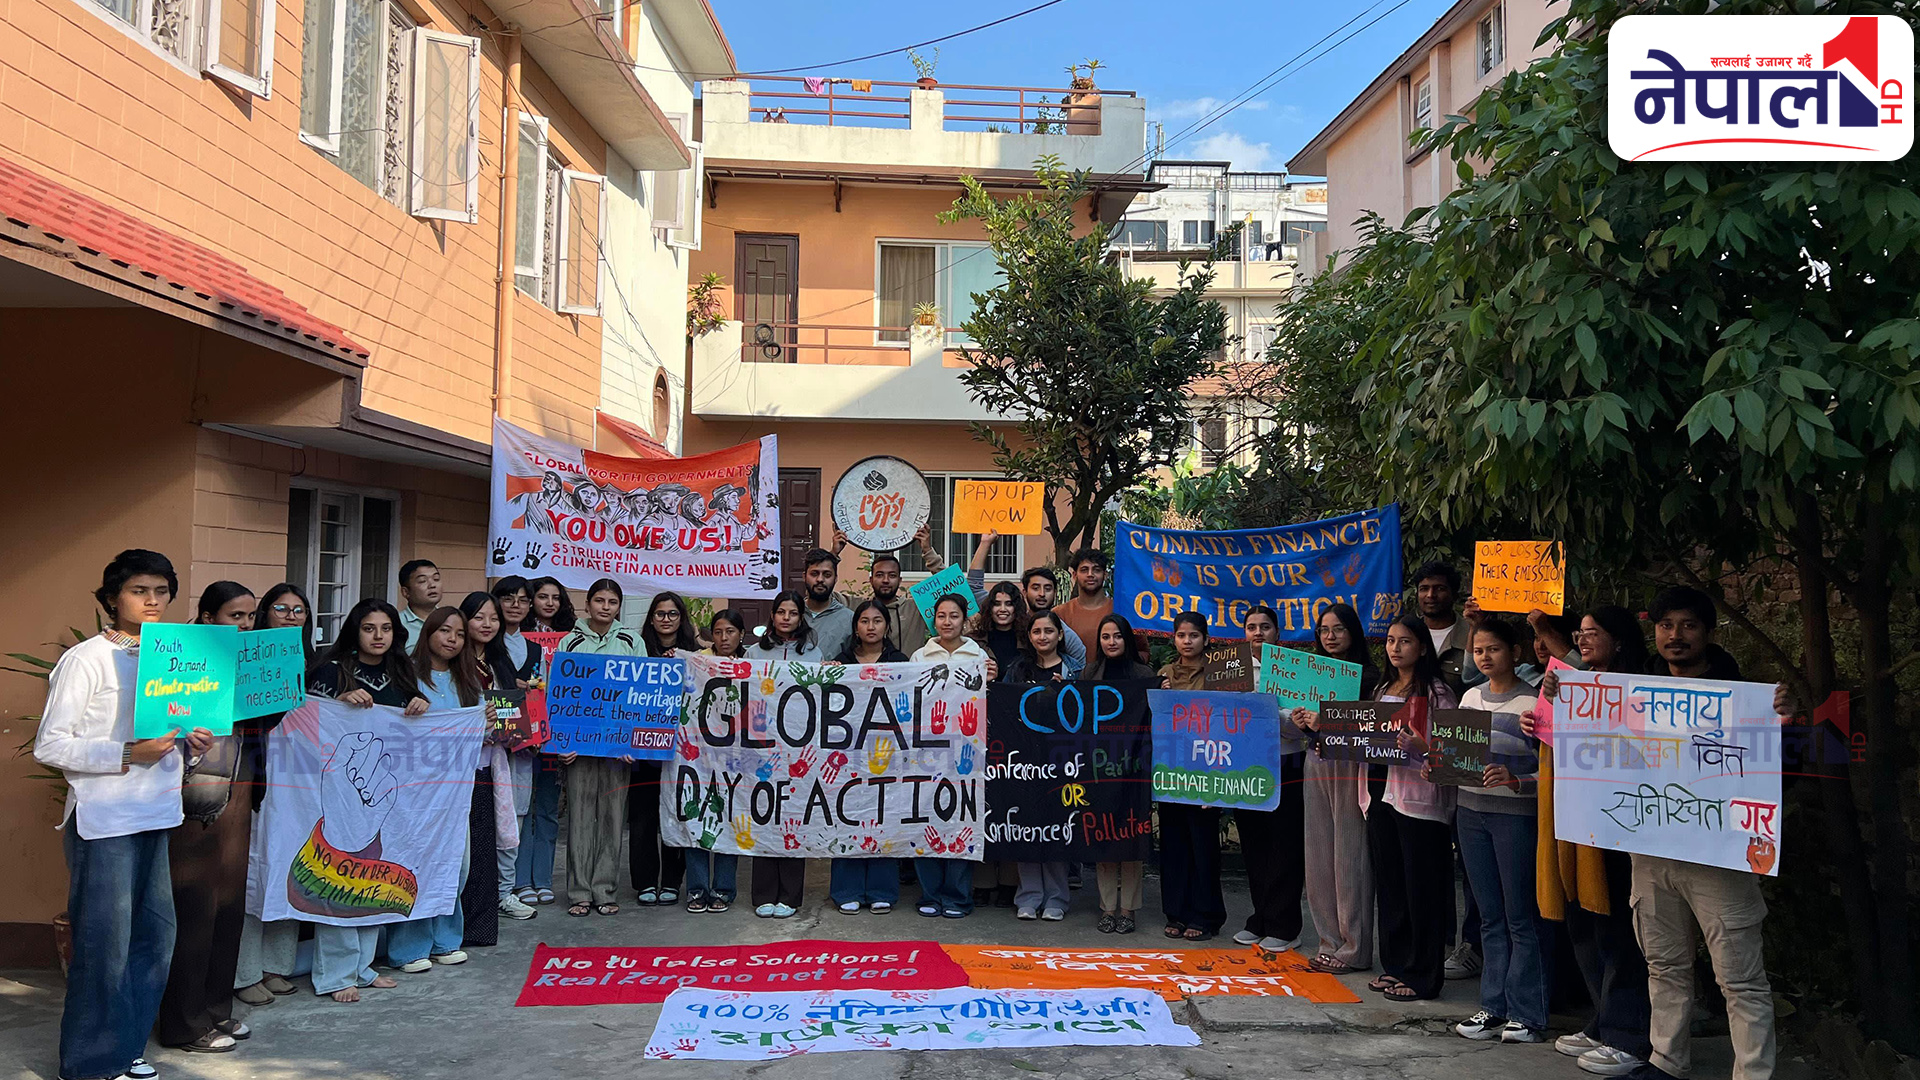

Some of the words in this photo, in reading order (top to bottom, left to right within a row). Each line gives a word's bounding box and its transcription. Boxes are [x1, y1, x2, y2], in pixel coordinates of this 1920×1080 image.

[587, 468, 641, 483] NORTH
[646, 465, 753, 483] GOVERNMENTS
[859, 491, 900, 513] PAY
[963, 484, 997, 500] PAY
[1006, 484, 1034, 501] UP
[980, 507, 1026, 523] NOW
[546, 509, 606, 543] YOU
[614, 523, 664, 549] OWE
[677, 524, 732, 554] US!
[1130, 530, 1241, 556] CLIMATE
[1246, 518, 1381, 555] FINANCE
[626, 553, 638, 561] IN
[1481, 543, 1503, 557] OUR
[1510, 543, 1542, 560] LOSS
[551, 555, 610, 572] CLIMATE
[615, 562, 684, 576] FINANCE
[688, 563, 747, 576] ANNUALLY
[1196, 564, 1219, 586] IS
[1225, 563, 1312, 587] YOUR
[1480, 563, 1508, 579] THEIR
[913, 578, 941, 597] YOUTH
[931, 575, 965, 601] DEMAND
[1477, 586, 1500, 600] TIME
[1504, 588, 1520, 602] FOR
[1524, 590, 1562, 606] JUSTICE
[1134, 591, 1358, 631] OBLIGTION
[154, 638, 183, 653] Youth
[236, 635, 277, 670] ptation
[280, 643, 288, 656] is
[289, 641, 302, 655] not
[1205, 647, 1238, 664] YOUTH
[561, 659, 598, 679] Our
[604, 659, 683, 686] RIVERS
[1206, 666, 1246, 682] CLIMATE
[1226, 660, 1241, 670] FOR
[1270, 648, 1300, 665] We're
[1307, 655, 1336, 679] Paying
[1340, 664, 1358, 678] the
[1271, 664, 1297, 680] Price
[275, 670, 281, 680] a
[145, 677, 183, 697] Climate
[245, 673, 303, 708] necessity!
[552, 685, 582, 700] are
[591, 687, 623, 701] our
[1265, 681, 1307, 702] Where's
[1309, 686, 1325, 702] the
[167, 701, 191, 716] Now
[549, 701, 605, 721] protect
[611, 703, 640, 722] them
[645, 709, 679, 725] before
[698, 677, 950, 750] GLOBAL
[1019, 684, 1124, 735] COP
[1172, 703, 1213, 733] PAY
[1223, 705, 1252, 734] UP
[1326, 708, 1376, 720] TOGETHER
[1631, 685, 1732, 737] जलवायु
[1359, 721, 1375, 732] WE
[1380, 719, 1401, 733] CAN
[1431, 721, 1453, 738] Less
[1455, 725, 1489, 746] Pollution
[550, 729, 571, 749] hey
[575, 728, 601, 744] turn
[606, 726, 630, 744] into
[632, 730, 675, 748] HISTORY
[1325, 735, 1348, 746] COOL
[1353, 736, 1369, 747] THE
[1192, 739, 1232, 767] FOR
[1064, 752, 1085, 779] of
[1452, 756, 1486, 773] Sollutio
[1153, 771, 1209, 793] CLIMATE
[1213, 777, 1266, 797] FINANCE
[676, 765, 742, 823] DAY
[750, 780, 791, 826] OF
[803, 775, 977, 826] ACTION
[1061, 783, 1091, 807] OR
[1062, 810, 1081, 845] of
[312, 843, 333, 867] NO
[336, 859, 391, 882] GENDER
[390, 870, 417, 898] JUSTICE
[306, 877, 380, 906] CLIMATE
[543, 957, 593, 970] No
[533, 971, 611, 987] Real
[618, 971, 698, 987] Zero
[712, 973, 752, 983] no
[766, 969, 826, 982] net
[840, 967, 918, 979] Zero
